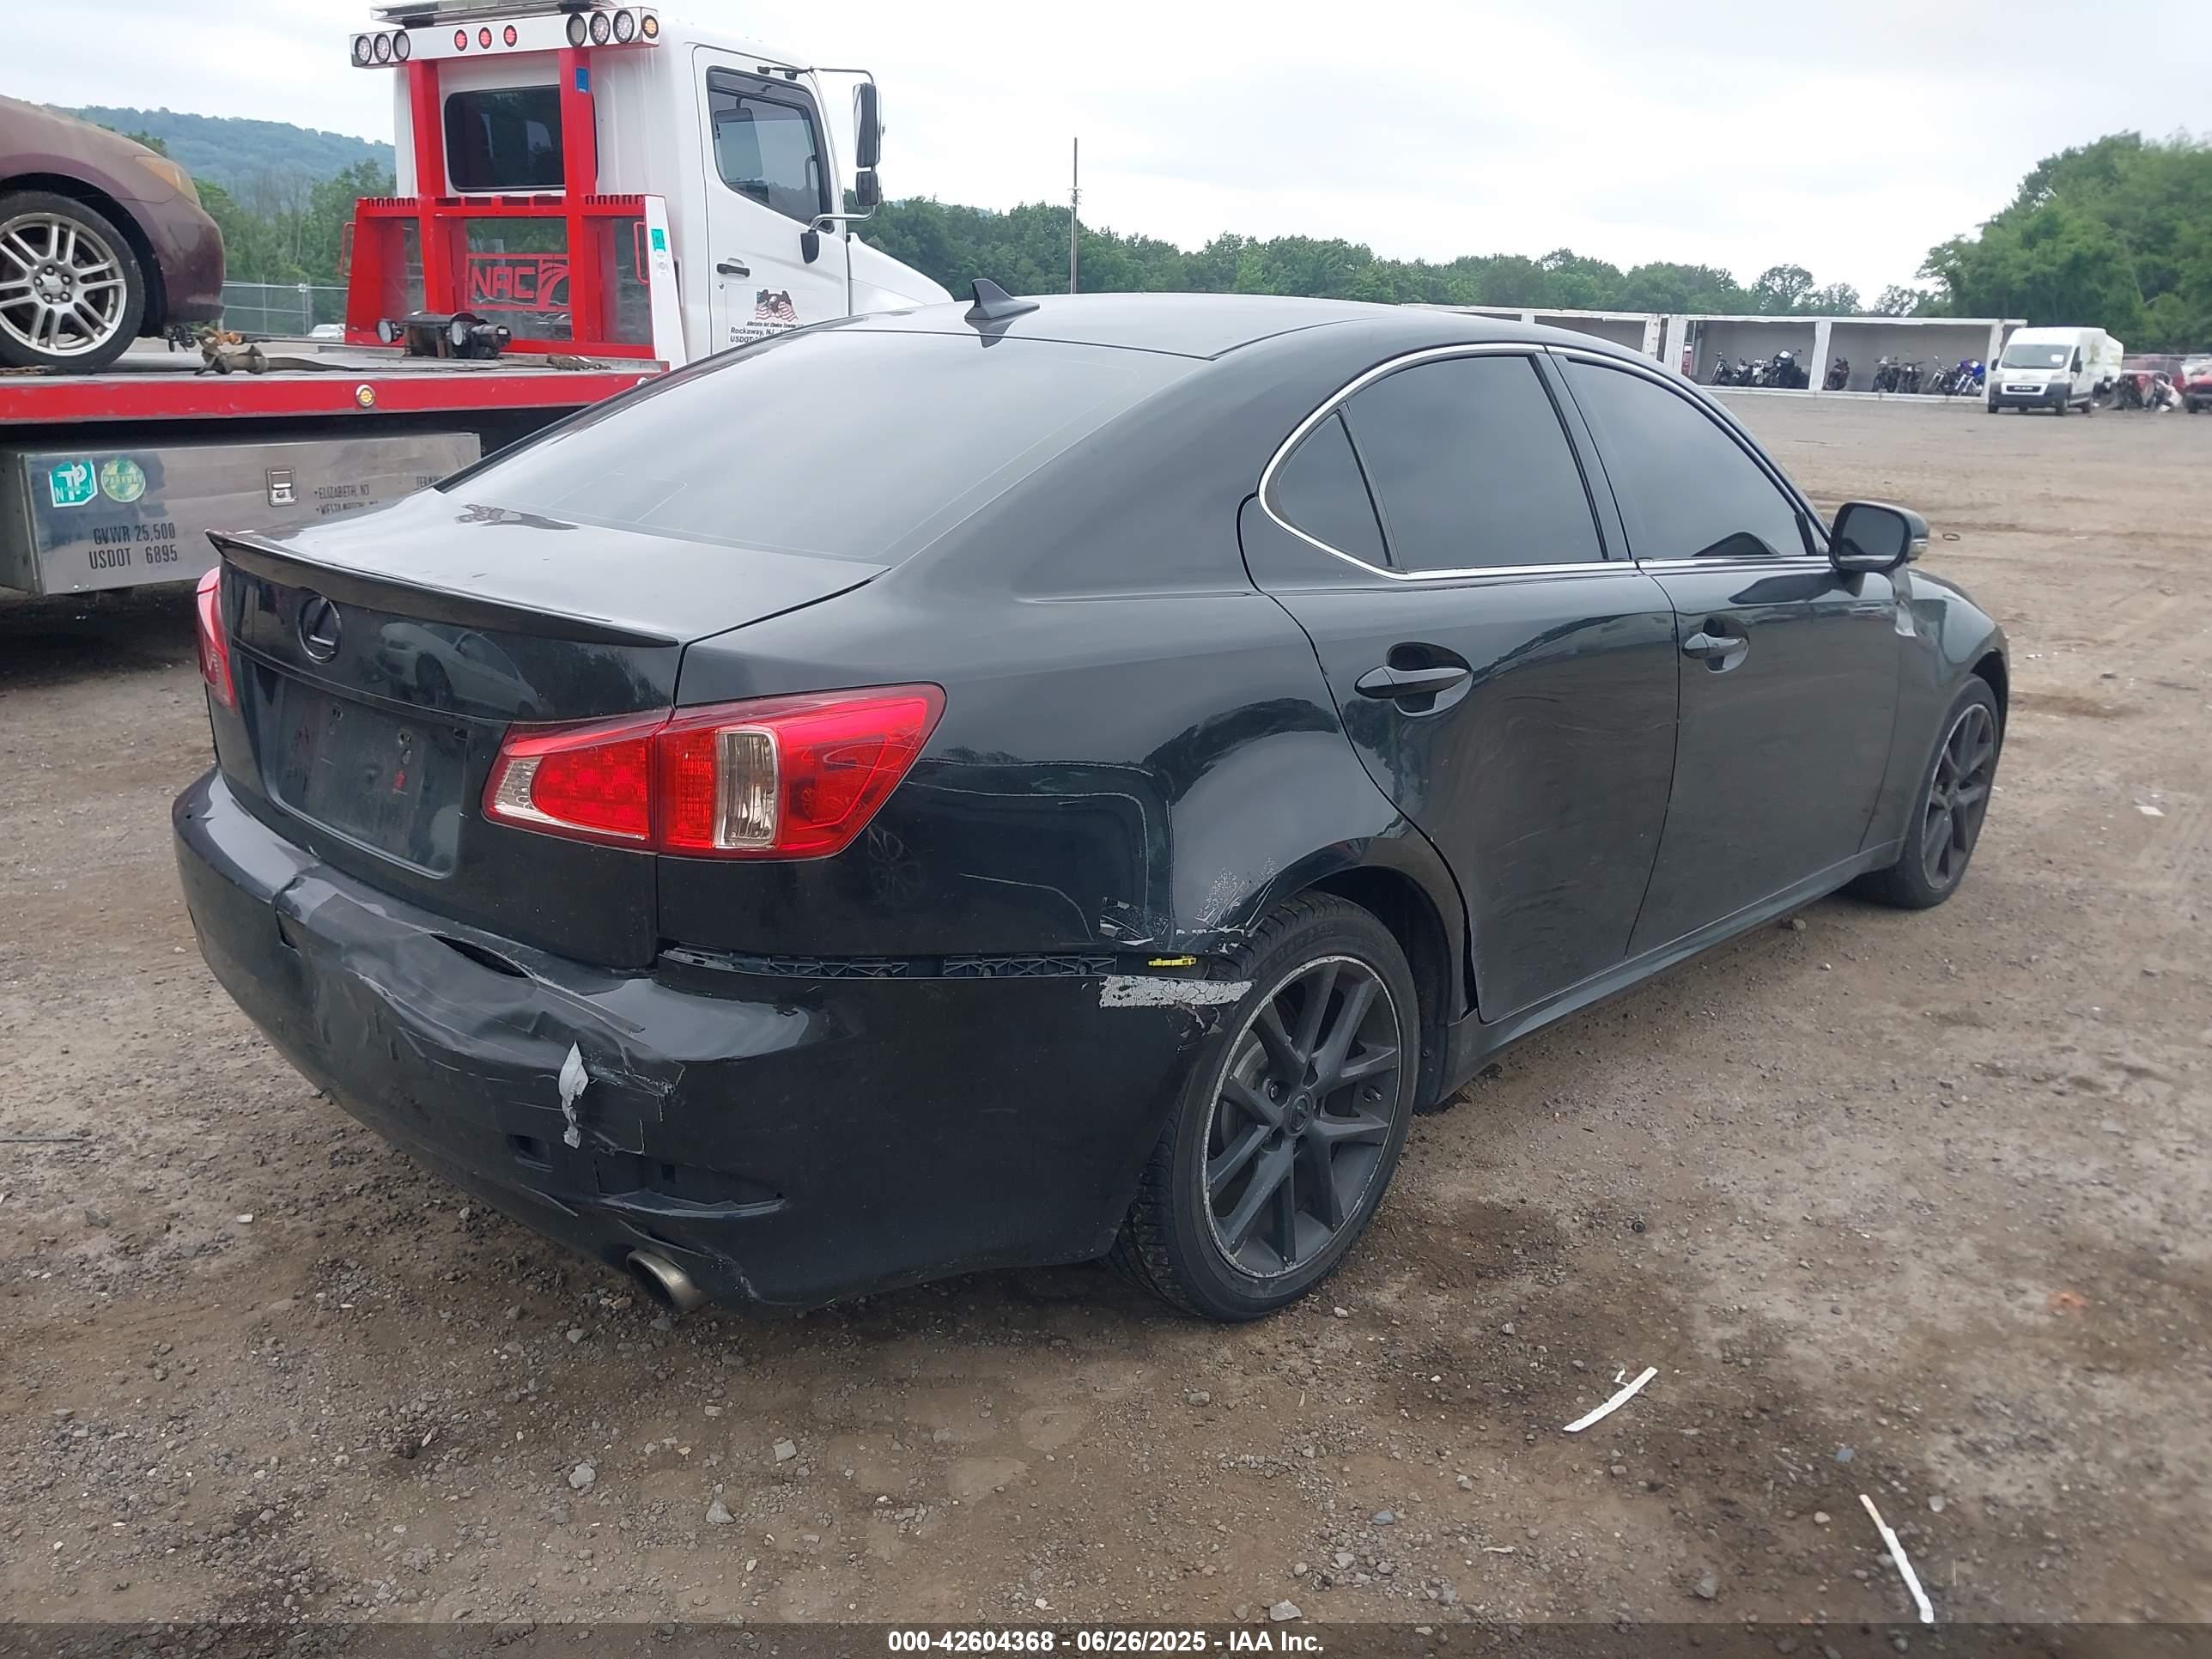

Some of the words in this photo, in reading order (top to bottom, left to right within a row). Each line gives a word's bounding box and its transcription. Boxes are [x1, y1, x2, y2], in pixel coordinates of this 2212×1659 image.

[93, 526, 131, 545] GVWR
[134, 522, 176, 543] 25,500
[88, 548, 131, 569] USDOT
[145, 544, 179, 564] 6895
